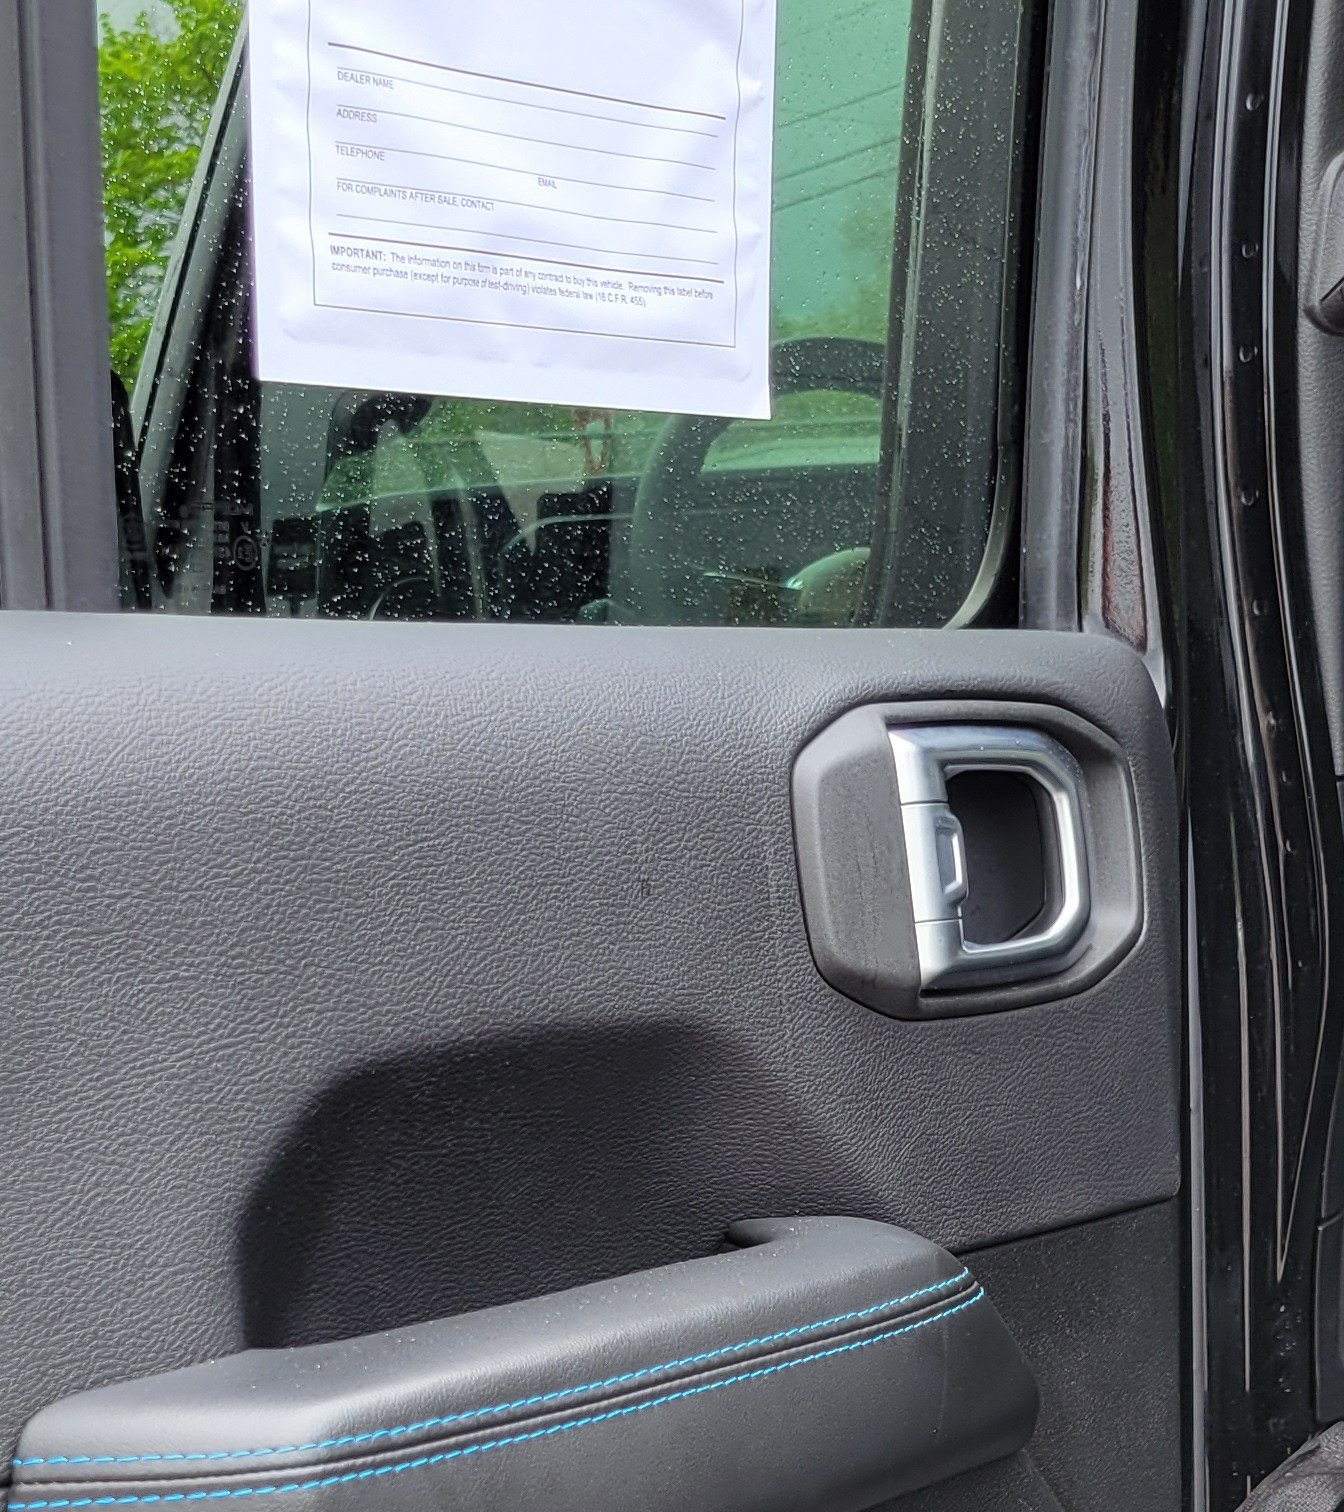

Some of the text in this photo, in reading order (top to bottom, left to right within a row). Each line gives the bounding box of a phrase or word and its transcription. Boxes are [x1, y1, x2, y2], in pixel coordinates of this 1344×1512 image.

[337, 70, 394, 90] DEALER NAME
[336, 108, 378, 124] ADDRESS
[335, 144, 386, 161] TELEPHONE
[336, 181, 354, 194] FOR
[355, 184, 407, 201] COMPLAINTS
[409, 191, 436, 204] AFTER
[538, 177, 558, 190] EMAIL
[330, 244, 387, 262] IMPORTANT:
[391, 252, 406, 265] The
[408, 254, 451, 270] information
[453, 261, 463, 271] on
[464, 261, 476, 272] this
[477, 262, 491, 274] form
[492, 265, 498, 275] is
[500, 266, 514, 278] part
[516, 267, 523, 278] of
[524, 270, 537, 282] any
[538, 271, 564, 284] contract
[565, 274, 572, 284] to
[573, 275, 585, 288] buy
[587, 277, 598, 288] this
[628, 282, 662, 297] Removing
[663, 285, 675, 297] this
[677, 287, 693, 298] label
[694, 288, 714, 301] before
[331, 261, 371, 275] consumer
[373, 266, 408, 280] purchase
[410, 269, 439, 284] (except
[440, 272, 451, 284] for
[452, 275, 479, 287] purpose
[480, 278, 487, 288] of
[488, 279, 530, 296] test-driving)
[531, 285, 557, 297] violates
[558, 287, 580, 299] federal
[582, 289, 594, 300] law
[595, 291, 606, 302] (16
